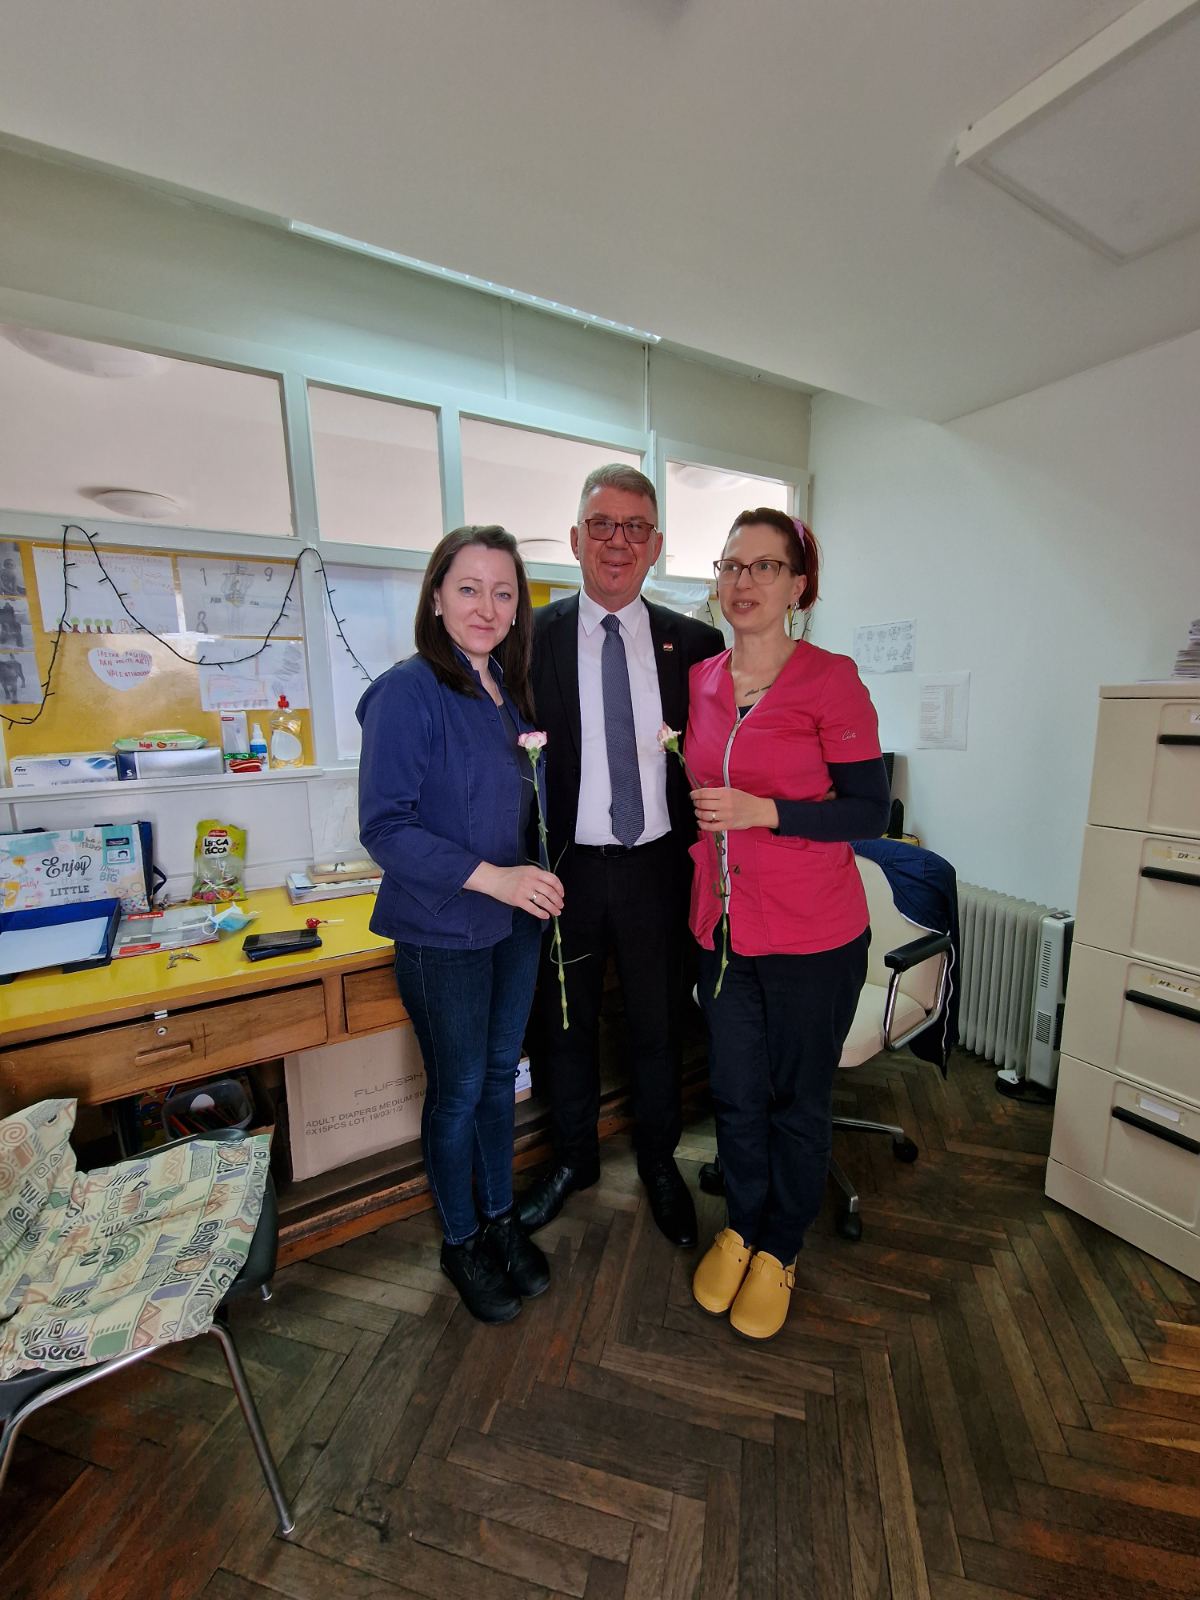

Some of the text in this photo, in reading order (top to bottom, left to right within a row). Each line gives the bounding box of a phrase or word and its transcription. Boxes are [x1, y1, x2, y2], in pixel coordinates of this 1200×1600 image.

[264, 566, 274, 582] 9
[42, 855, 92, 878] Enjoy
[99, 872, 118, 882] BIG
[50, 884, 90, 897] LITTLE
[306, 1115, 337, 1128] ADULT
[338, 1105, 378, 1121] DIAPERS
[379, 1093, 414, 1110] MEDIUM
[305, 1120, 347, 1136] 6X15PCS
[349, 1117, 366, 1127] LOT
